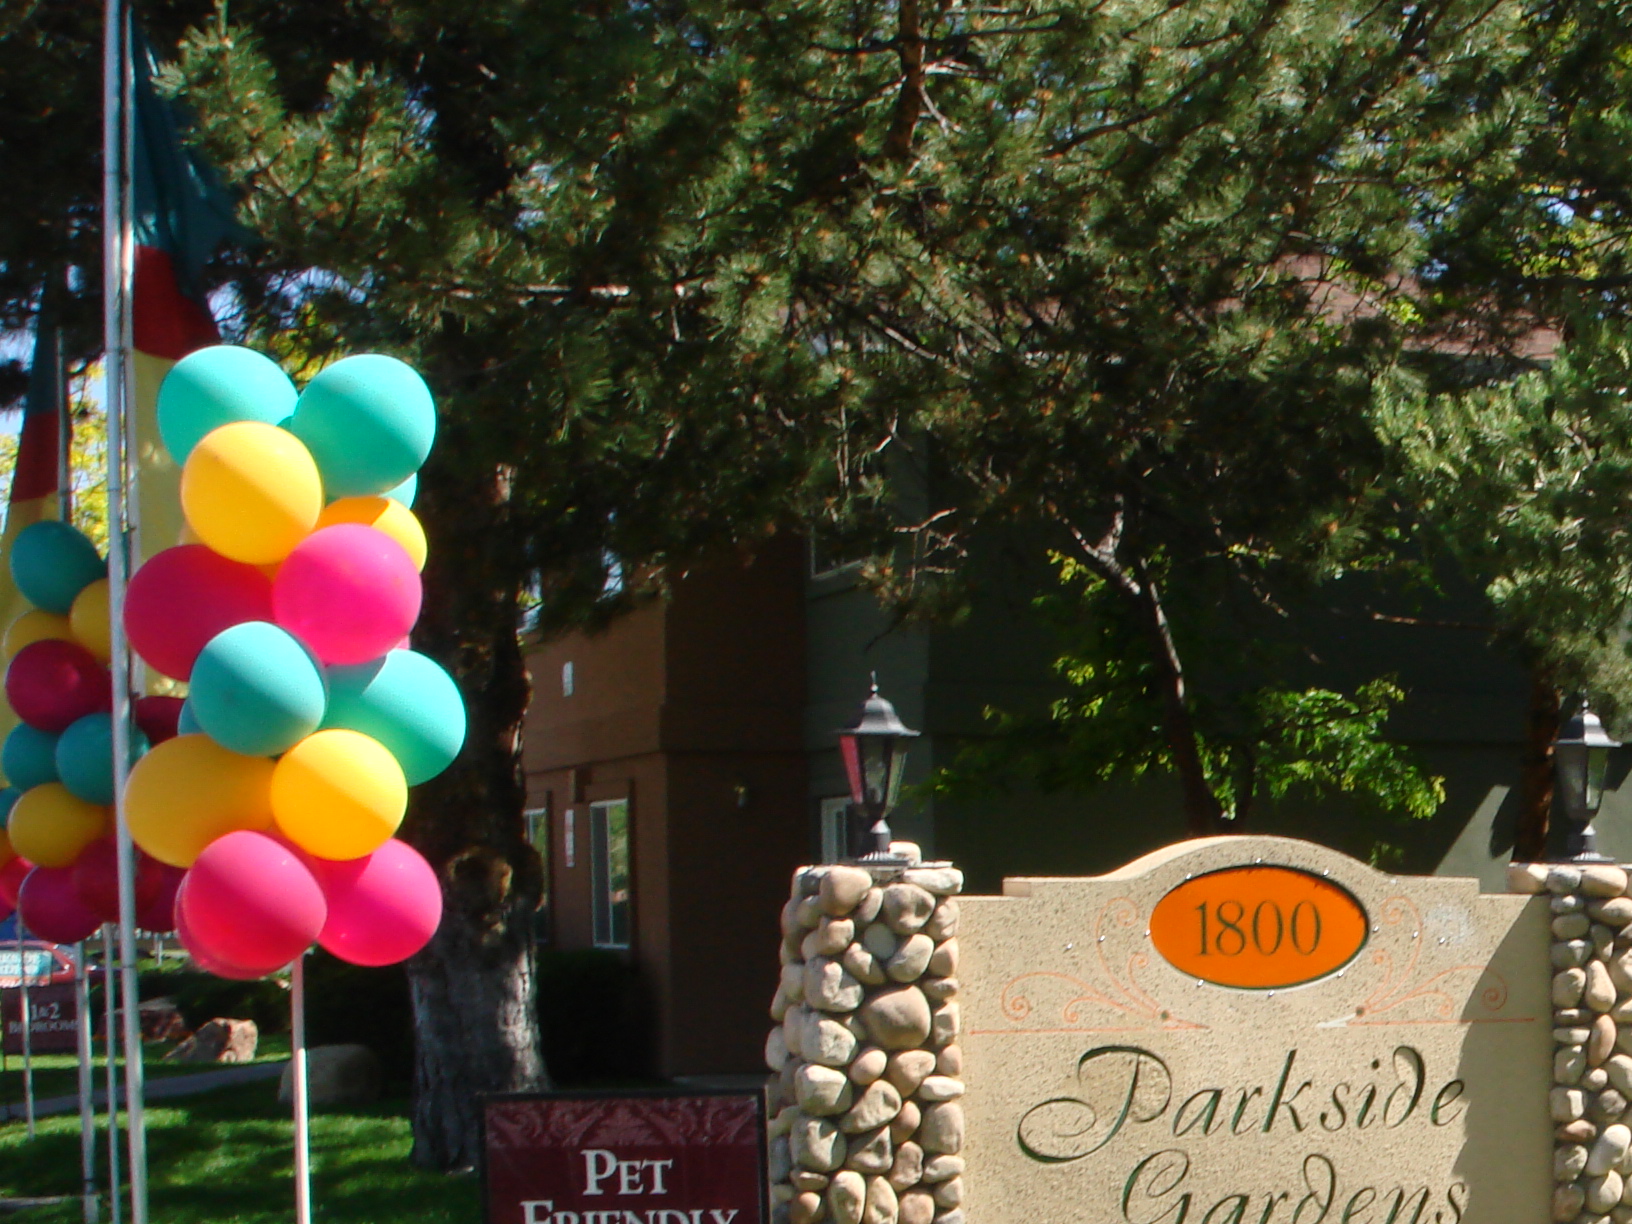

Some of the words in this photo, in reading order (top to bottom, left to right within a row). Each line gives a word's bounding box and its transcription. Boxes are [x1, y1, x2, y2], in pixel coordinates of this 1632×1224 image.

[1195, 900, 1322, 956] 1800
[1017, 1045, 1466, 1163] Parkside
[580, 1149, 673, 1195] PET
